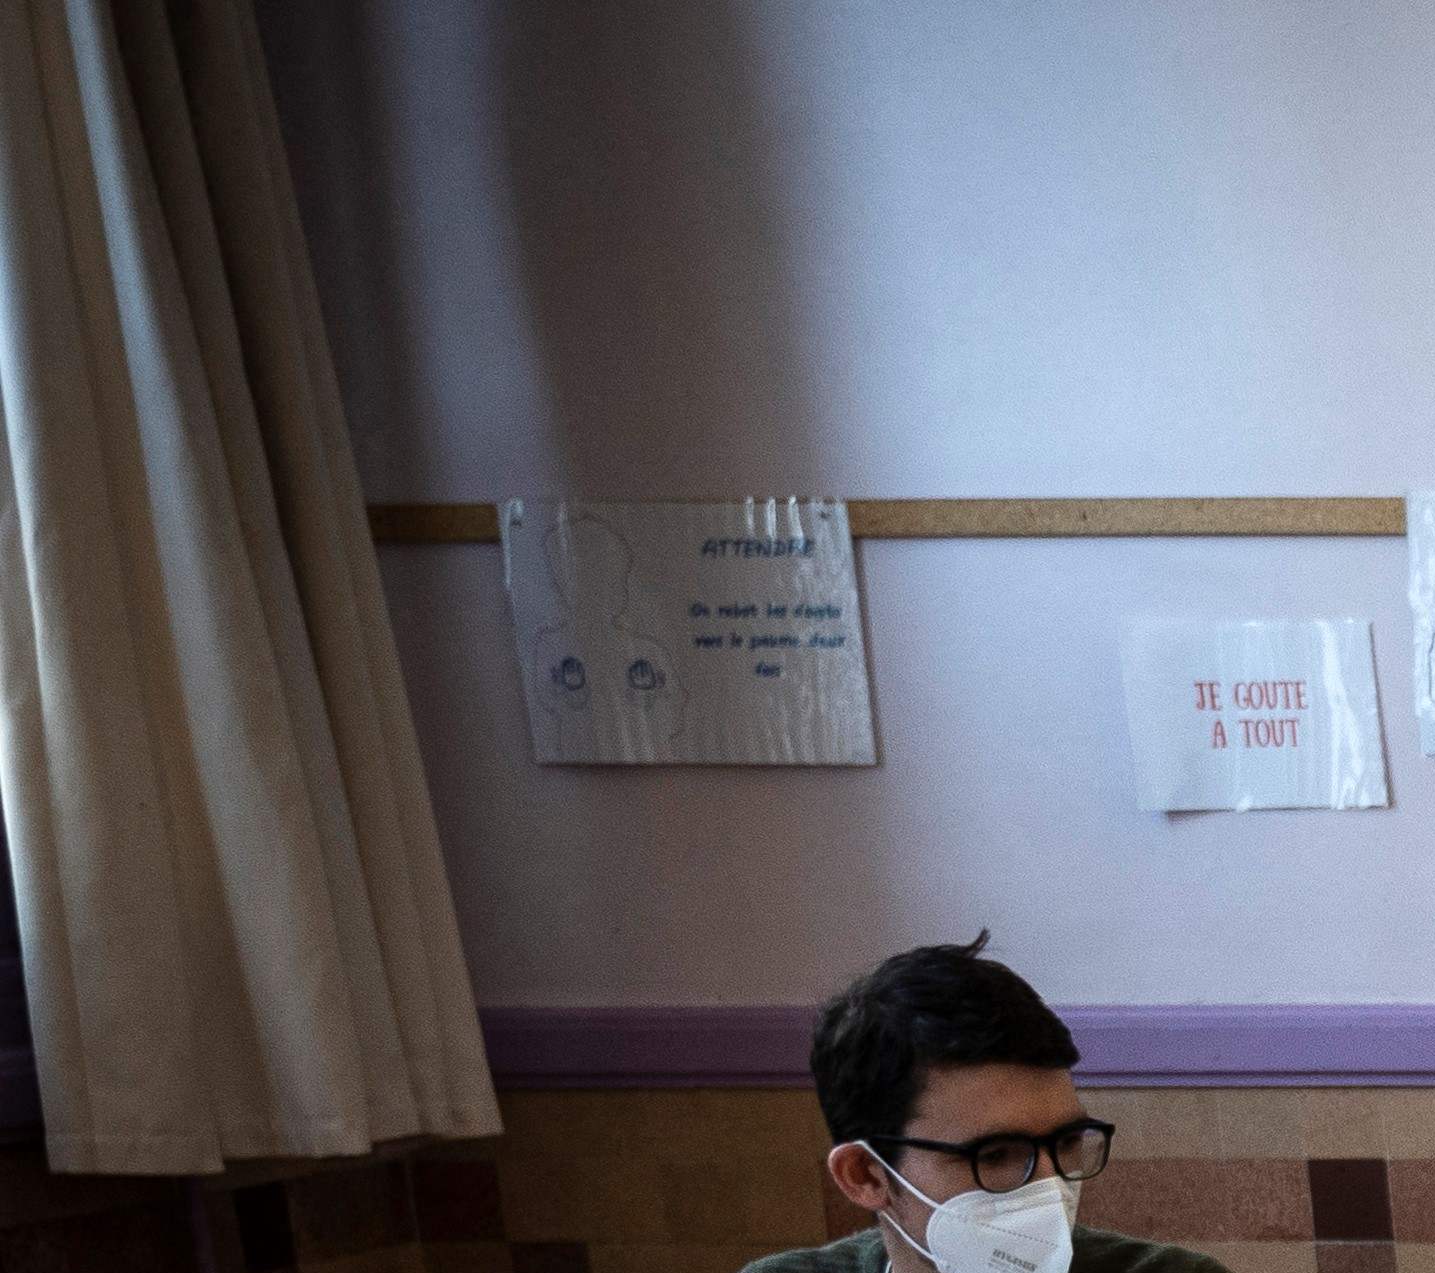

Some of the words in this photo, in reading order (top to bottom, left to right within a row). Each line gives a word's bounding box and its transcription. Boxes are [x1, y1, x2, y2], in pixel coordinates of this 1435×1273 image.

[1195, 681, 1222, 711] JE
[1234, 680, 1308, 711] GOUTE
[1212, 719, 1228, 749] A
[1238, 718, 1299, 749] TOUT
